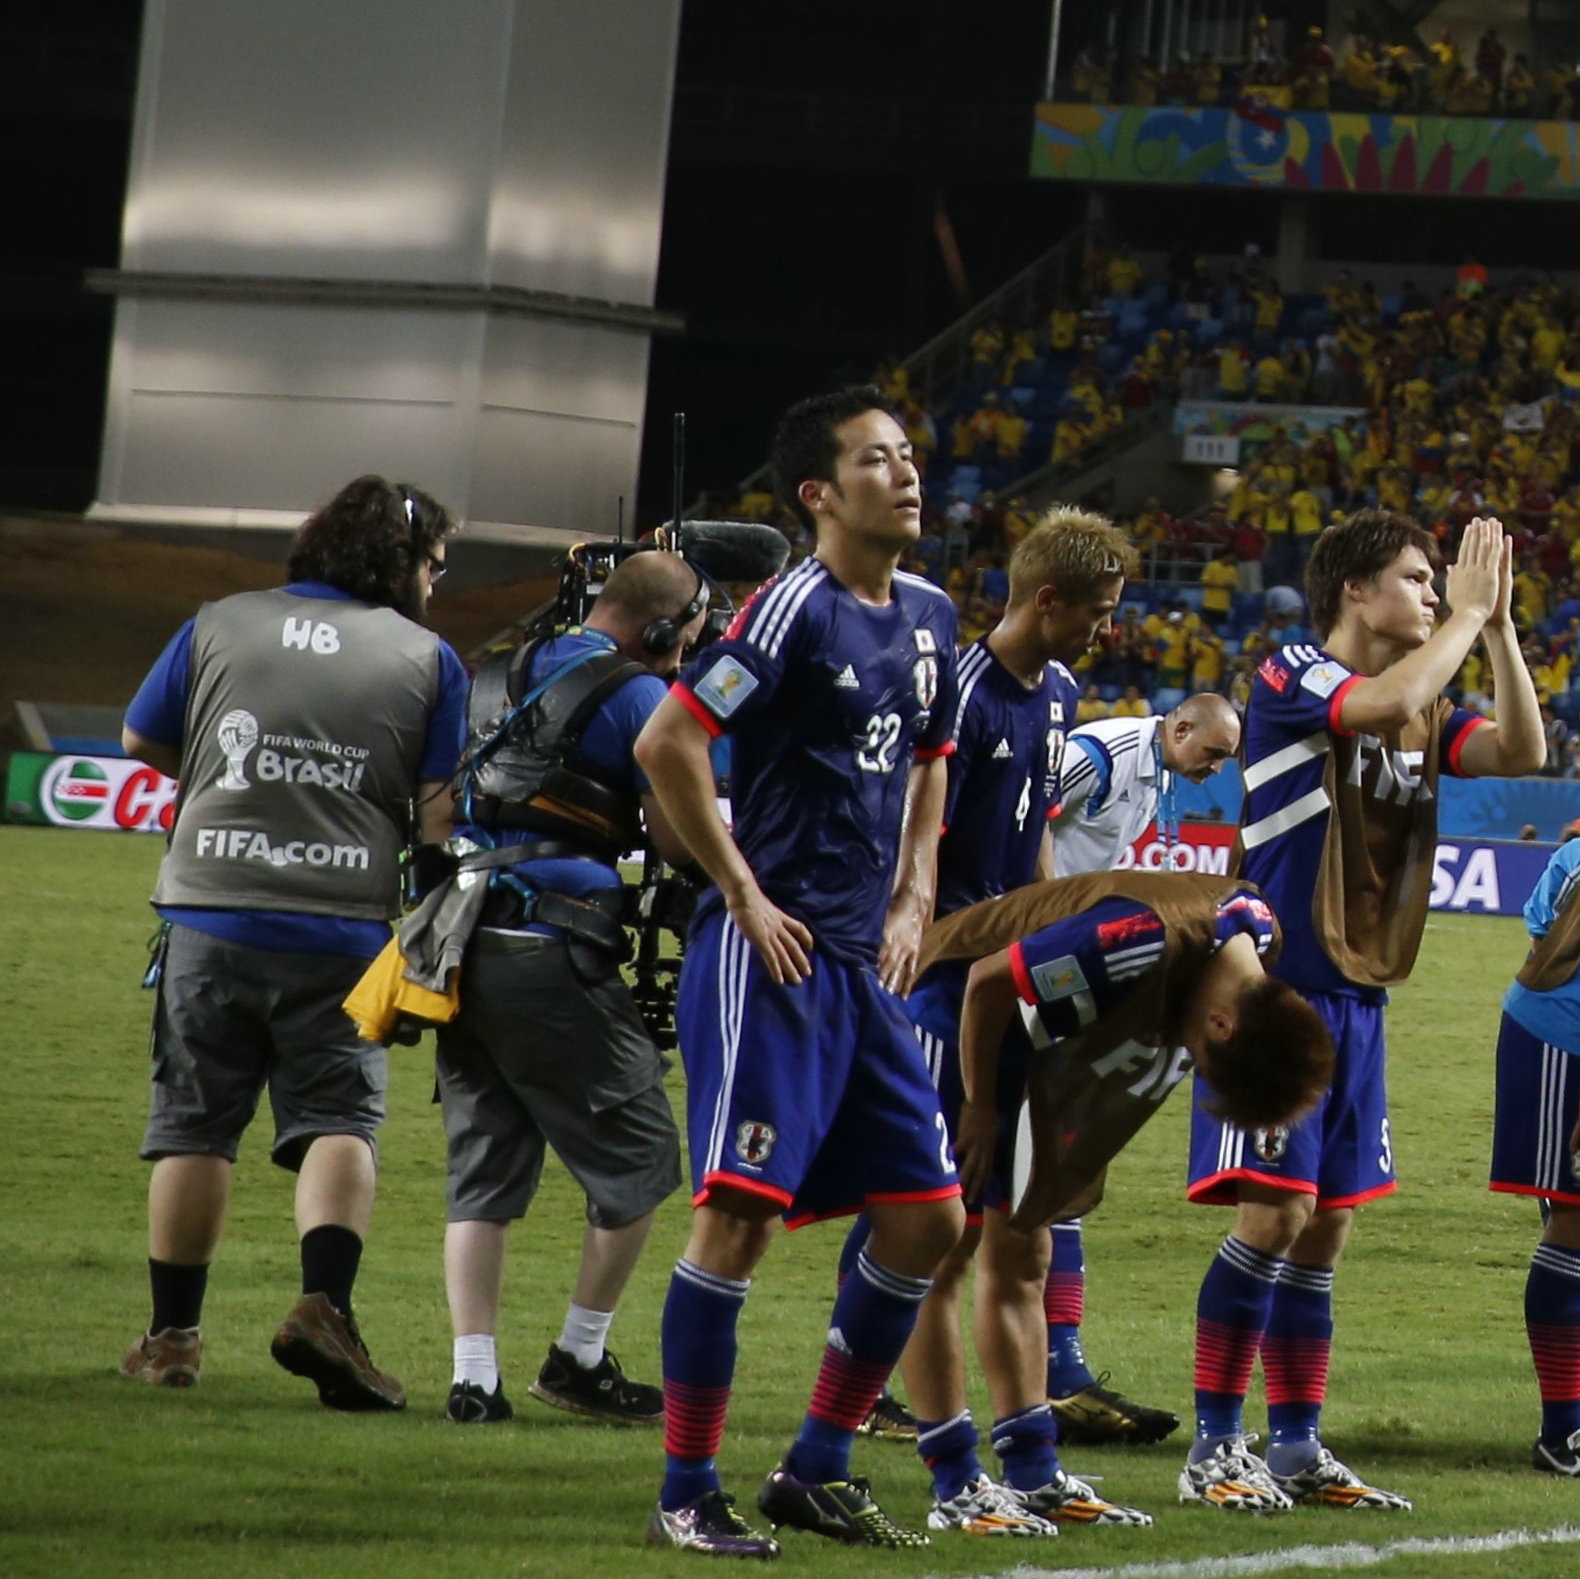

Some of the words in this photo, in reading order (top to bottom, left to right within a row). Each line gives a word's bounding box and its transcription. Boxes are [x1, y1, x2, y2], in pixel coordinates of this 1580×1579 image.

[282, 617, 341, 654] HB
[263, 734, 291, 749] FIFA
[294, 737, 341, 756] WORLD
[344, 746, 371, 759] CUP
[858, 713, 902, 774] 22
[256, 748, 366, 792] Brasil
[196, 829, 370, 871] FIFA.com
